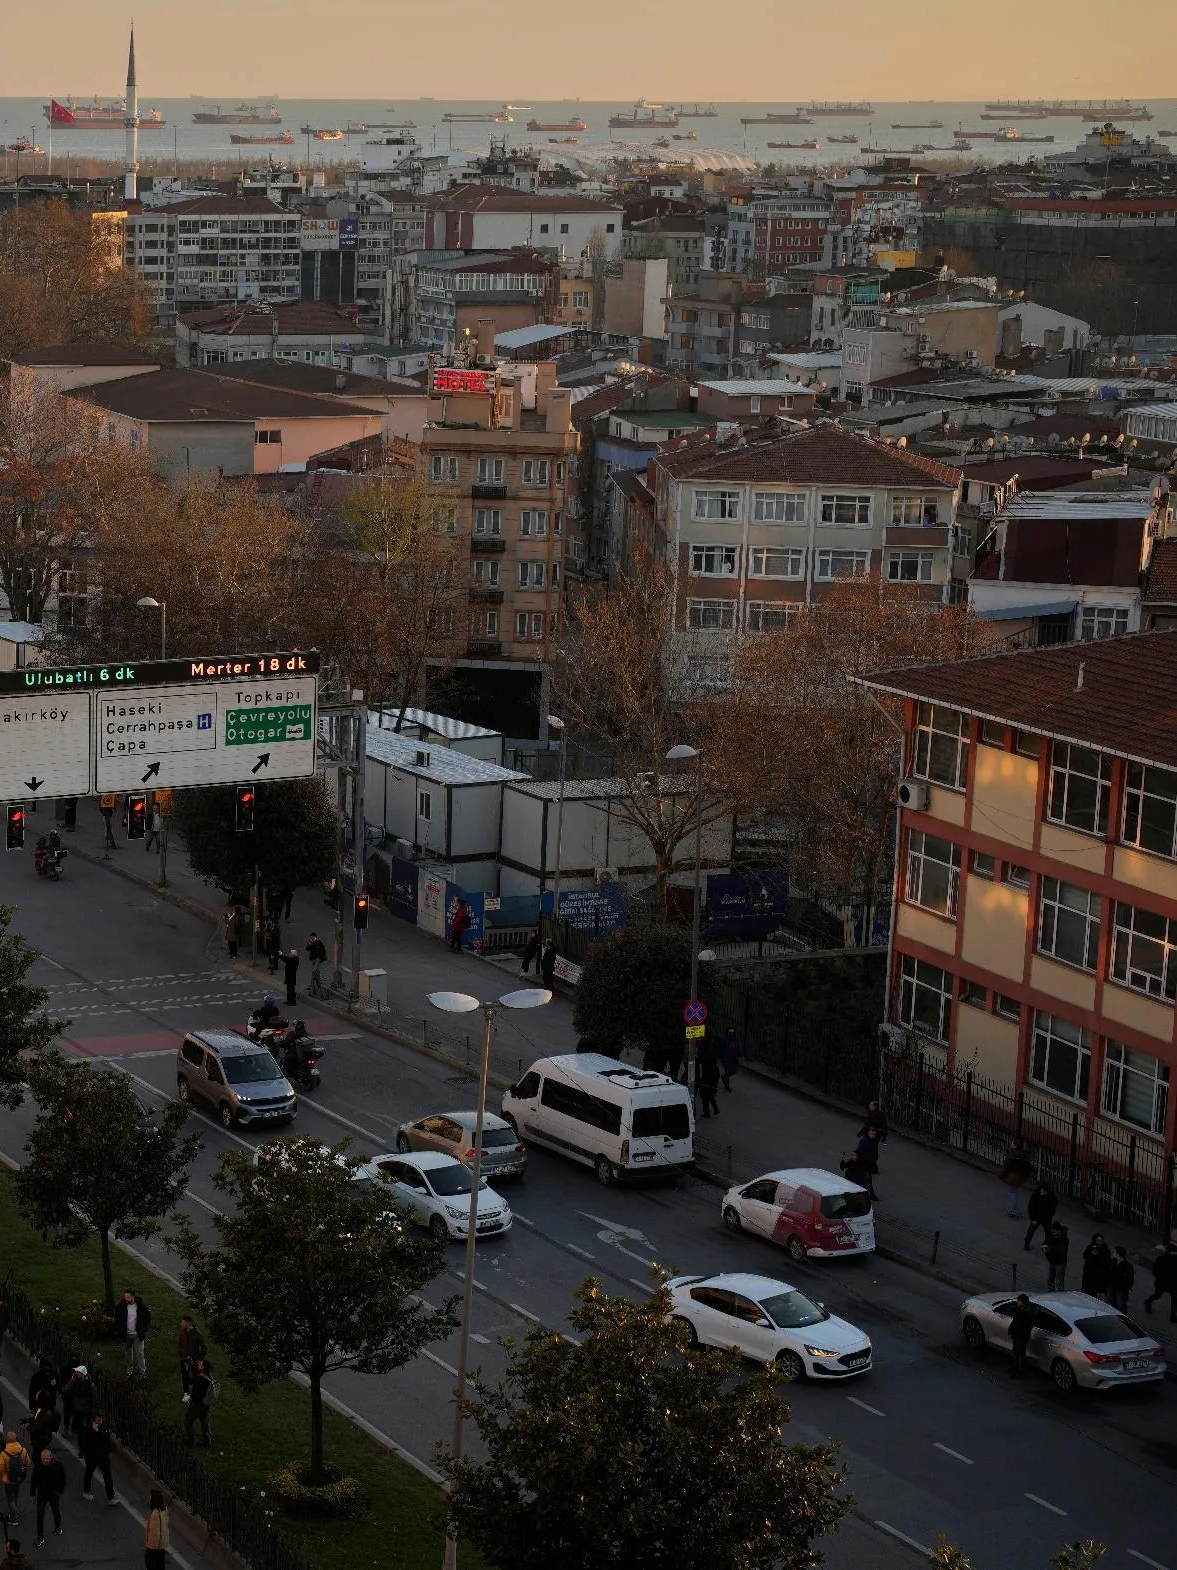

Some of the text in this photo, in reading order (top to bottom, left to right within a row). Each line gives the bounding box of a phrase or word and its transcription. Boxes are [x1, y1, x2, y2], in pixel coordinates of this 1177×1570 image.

[437, 377, 487, 393] HOTEL
[192, 657, 307, 677] Merter 18 dk
[25, 668, 135, 686] Ulubatlı 6 dk
[236, 690, 300, 705] Topkapı
[106, 703, 162, 717] Haseki
[227, 708, 310, 726] Çevreyolu
[106, 719, 193, 735] Cerrahpaşa
[227, 727, 283, 741] Otogar
[106, 740, 147, 754] Çapa
